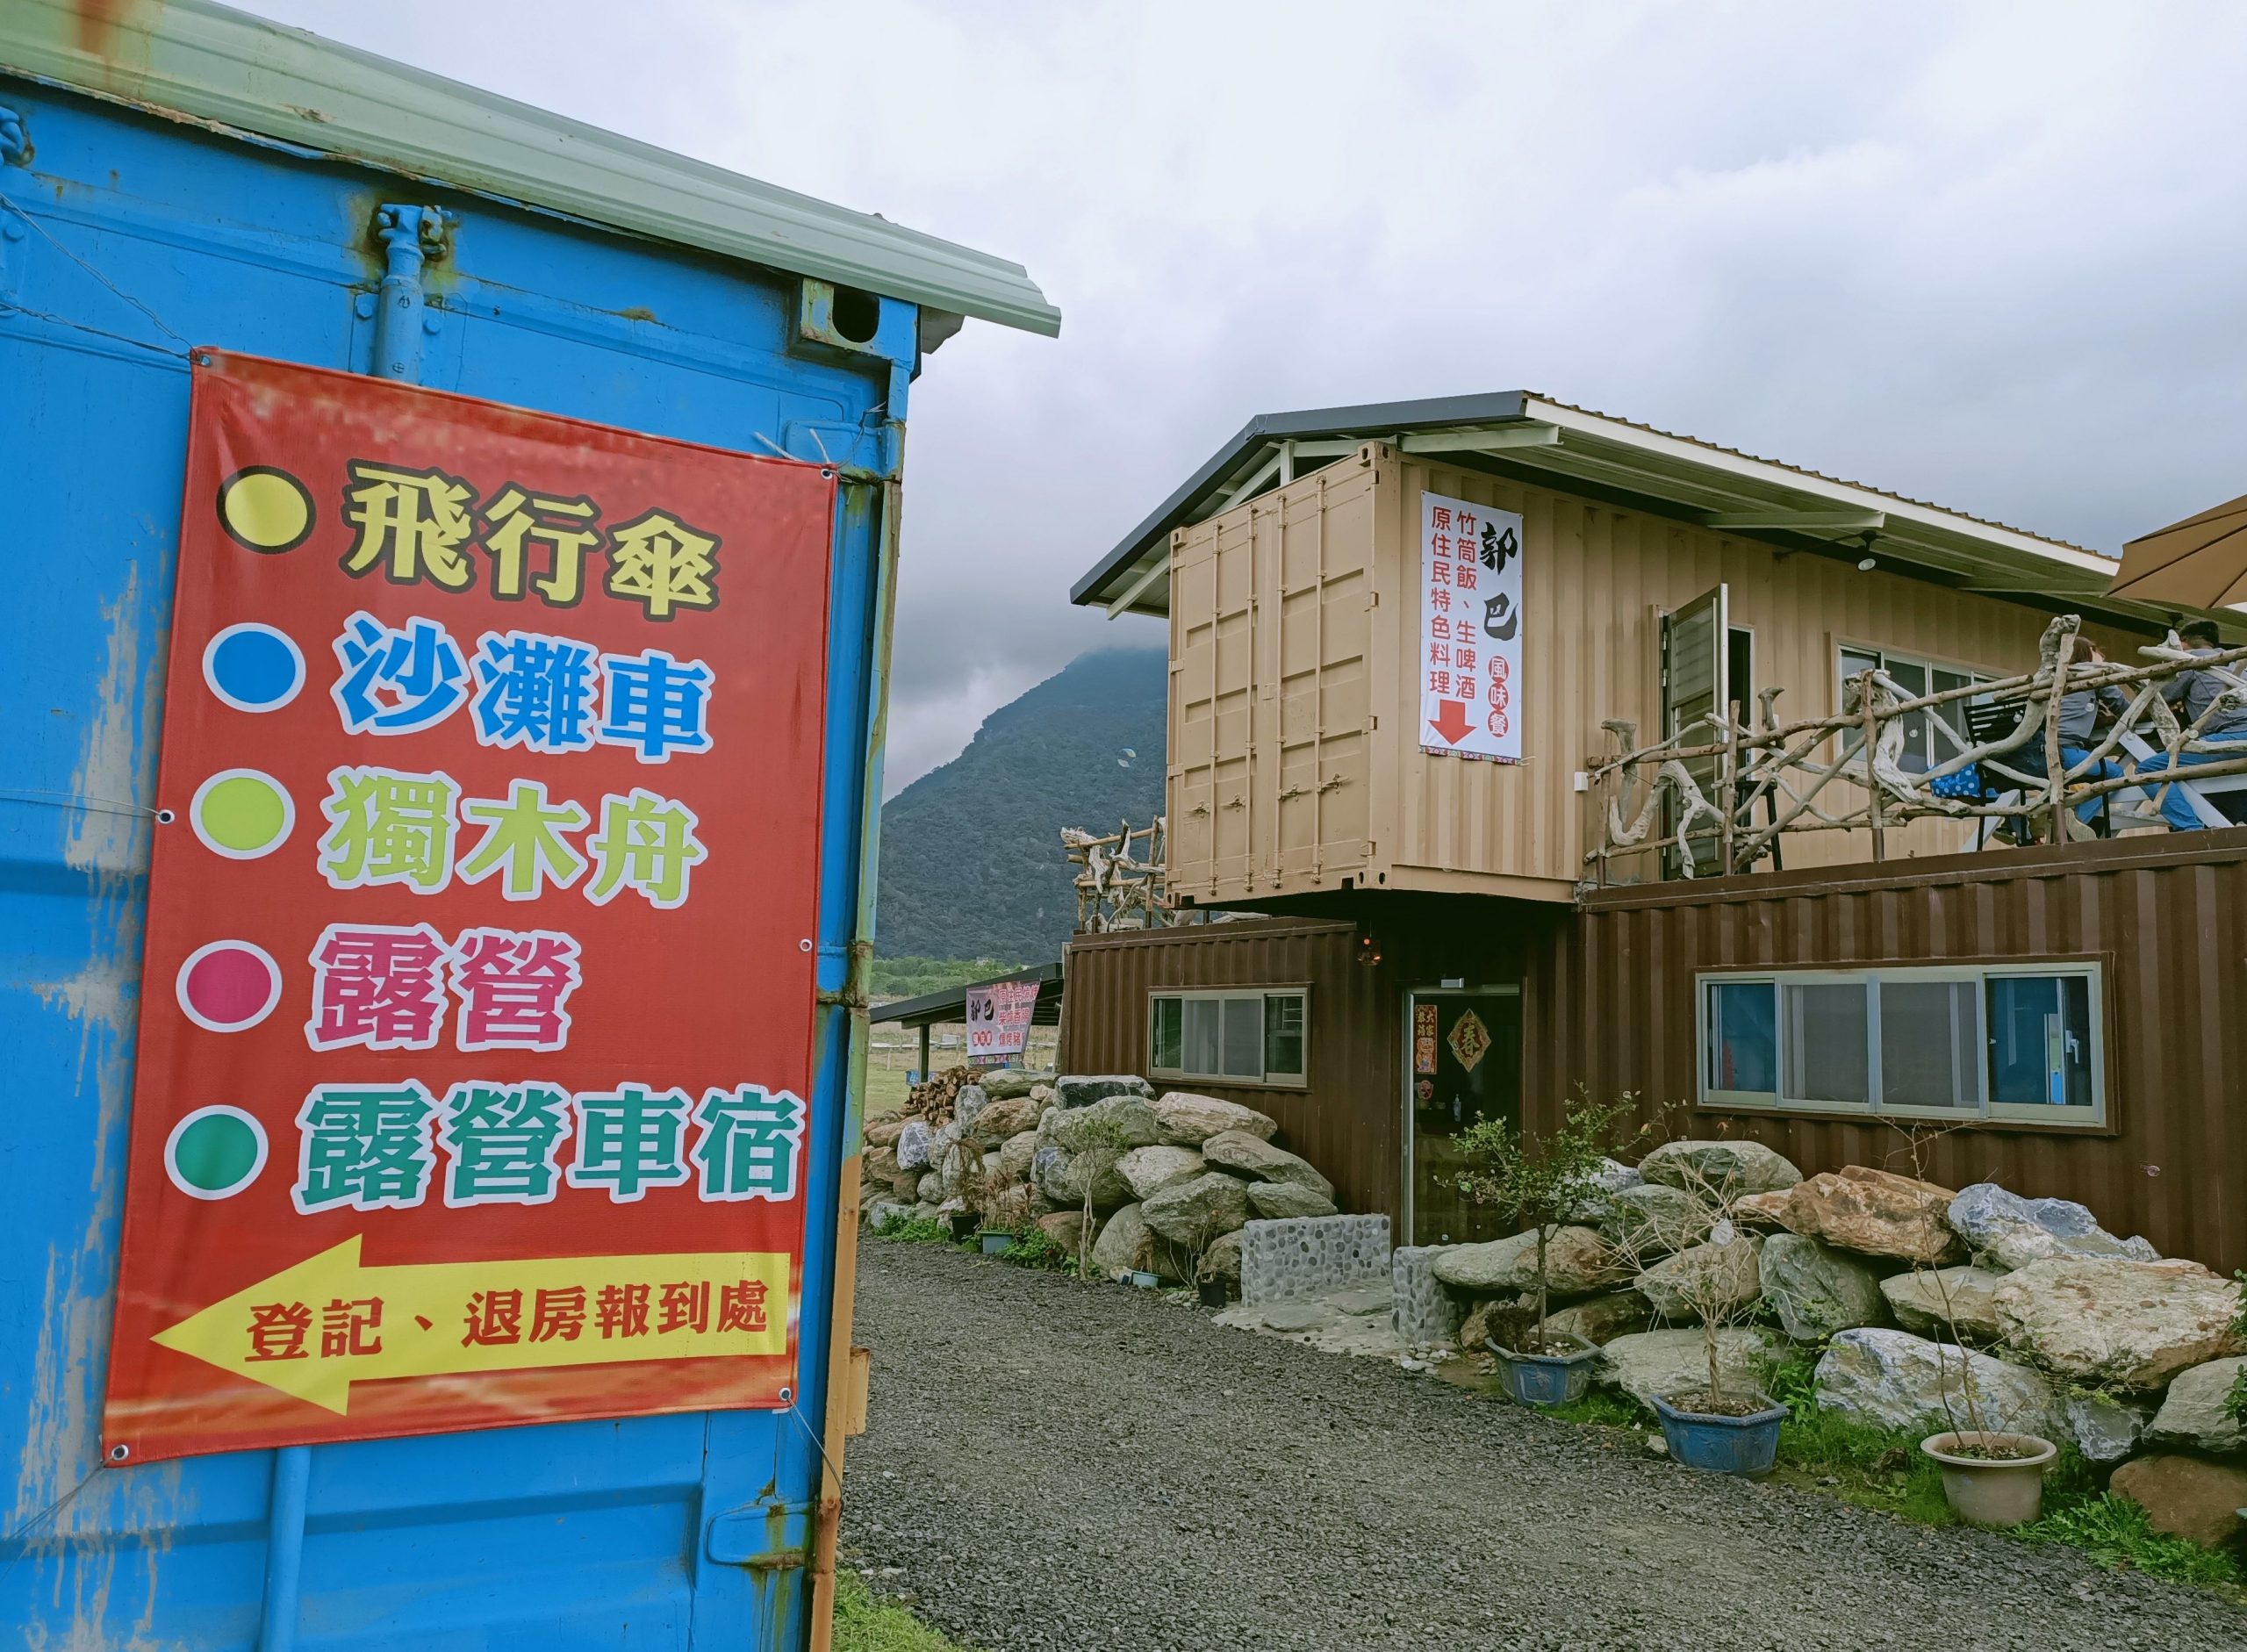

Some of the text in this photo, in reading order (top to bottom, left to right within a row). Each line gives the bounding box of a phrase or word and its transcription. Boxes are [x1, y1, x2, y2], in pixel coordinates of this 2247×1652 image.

[342, 461, 718, 619] 飛行傘
[1430, 506, 1451, 695] 原住民特色料理
[1456, 510, 1476, 700] 竹筒飯、生啤酒
[333, 614, 709, 761] 沙灘車
[1489, 657, 1509, 737] 風味餐
[319, 769, 704, 906] 獨木舟
[308, 925, 580, 1049] 露營
[1461, 1024, 1481, 1056] 春
[295, 1082, 802, 1211] 露營車宿
[243, 1278, 771, 1363] 登記、退房報到處
